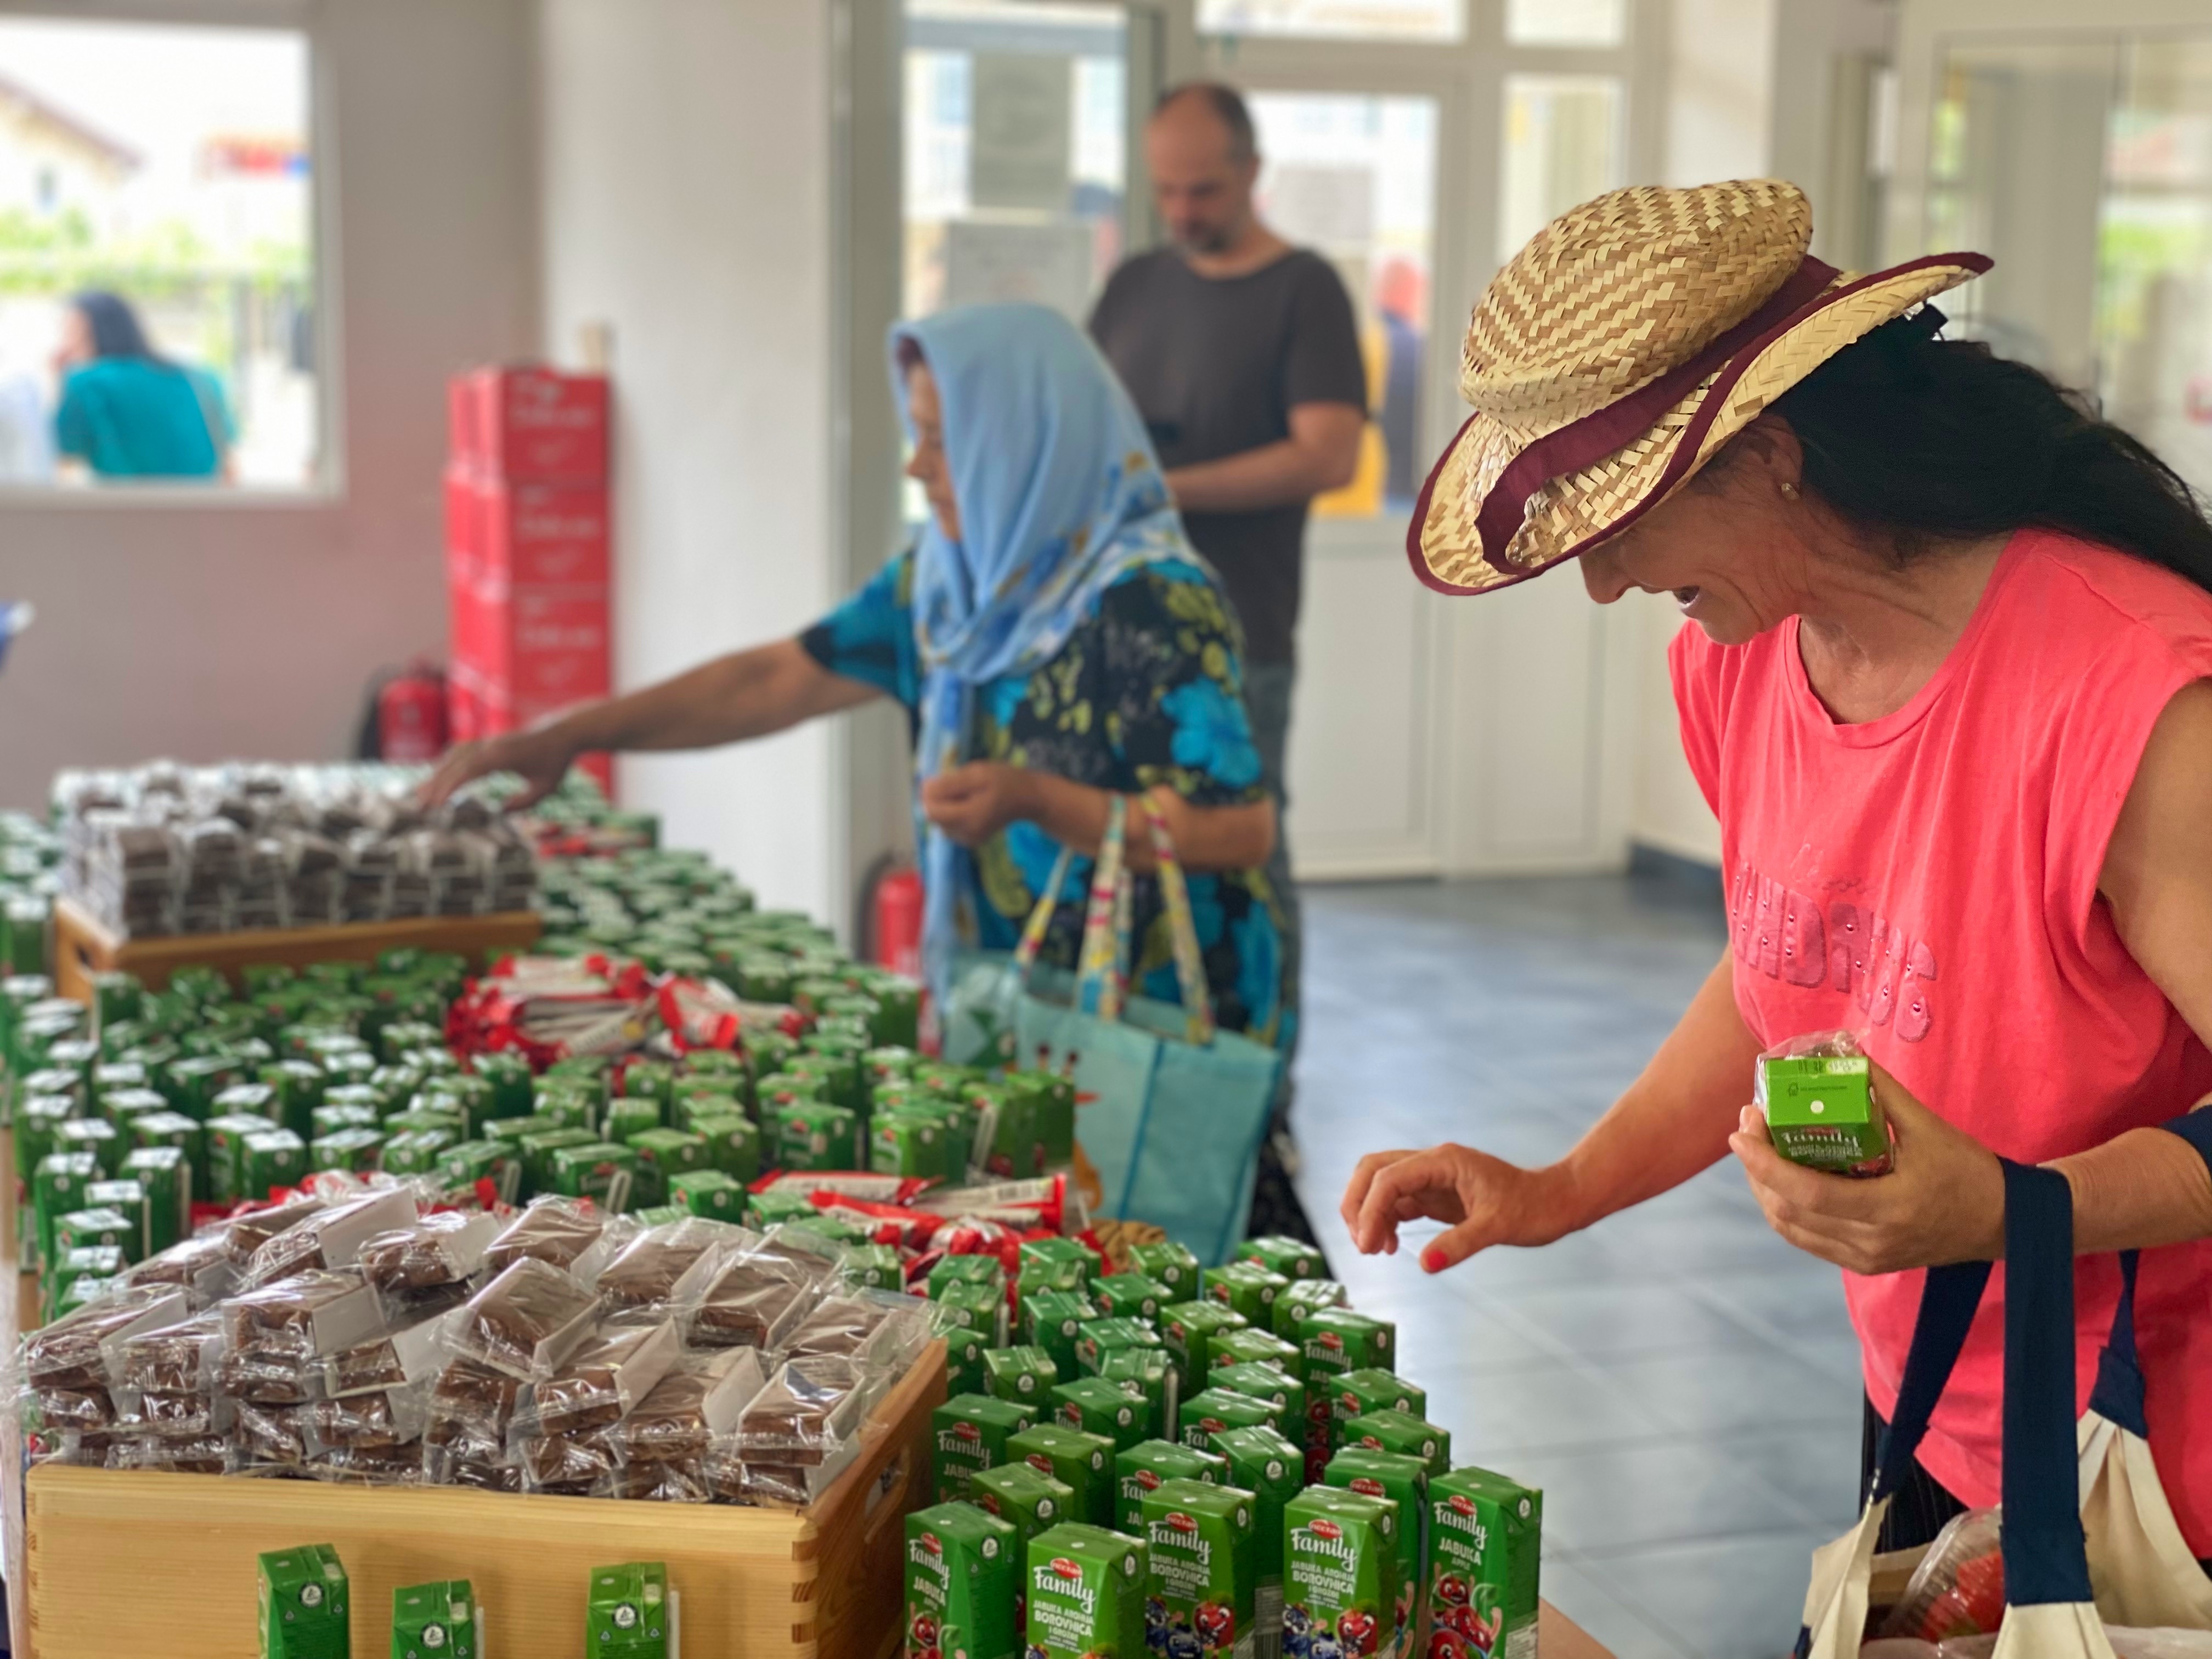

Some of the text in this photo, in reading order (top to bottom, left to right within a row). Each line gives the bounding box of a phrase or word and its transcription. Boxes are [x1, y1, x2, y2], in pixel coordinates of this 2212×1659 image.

[937, 1430, 992, 1470] Family
[1148, 1521, 1212, 1565] Family
[1434, 1502, 1488, 1550] Family
[909, 1539, 950, 1590] Family
[1290, 1528, 1357, 1572] Family
[1438, 1537, 1482, 1566] JABUKA
[913, 1576, 946, 1606] JABUKA
[1033, 1566, 1096, 1614] Family
[1150, 1563, 1210, 1587] BOROVNICA
[1293, 1570, 1354, 1595] BOROVNICA
[1035, 1610, 1093, 1638] BOROVNICA
